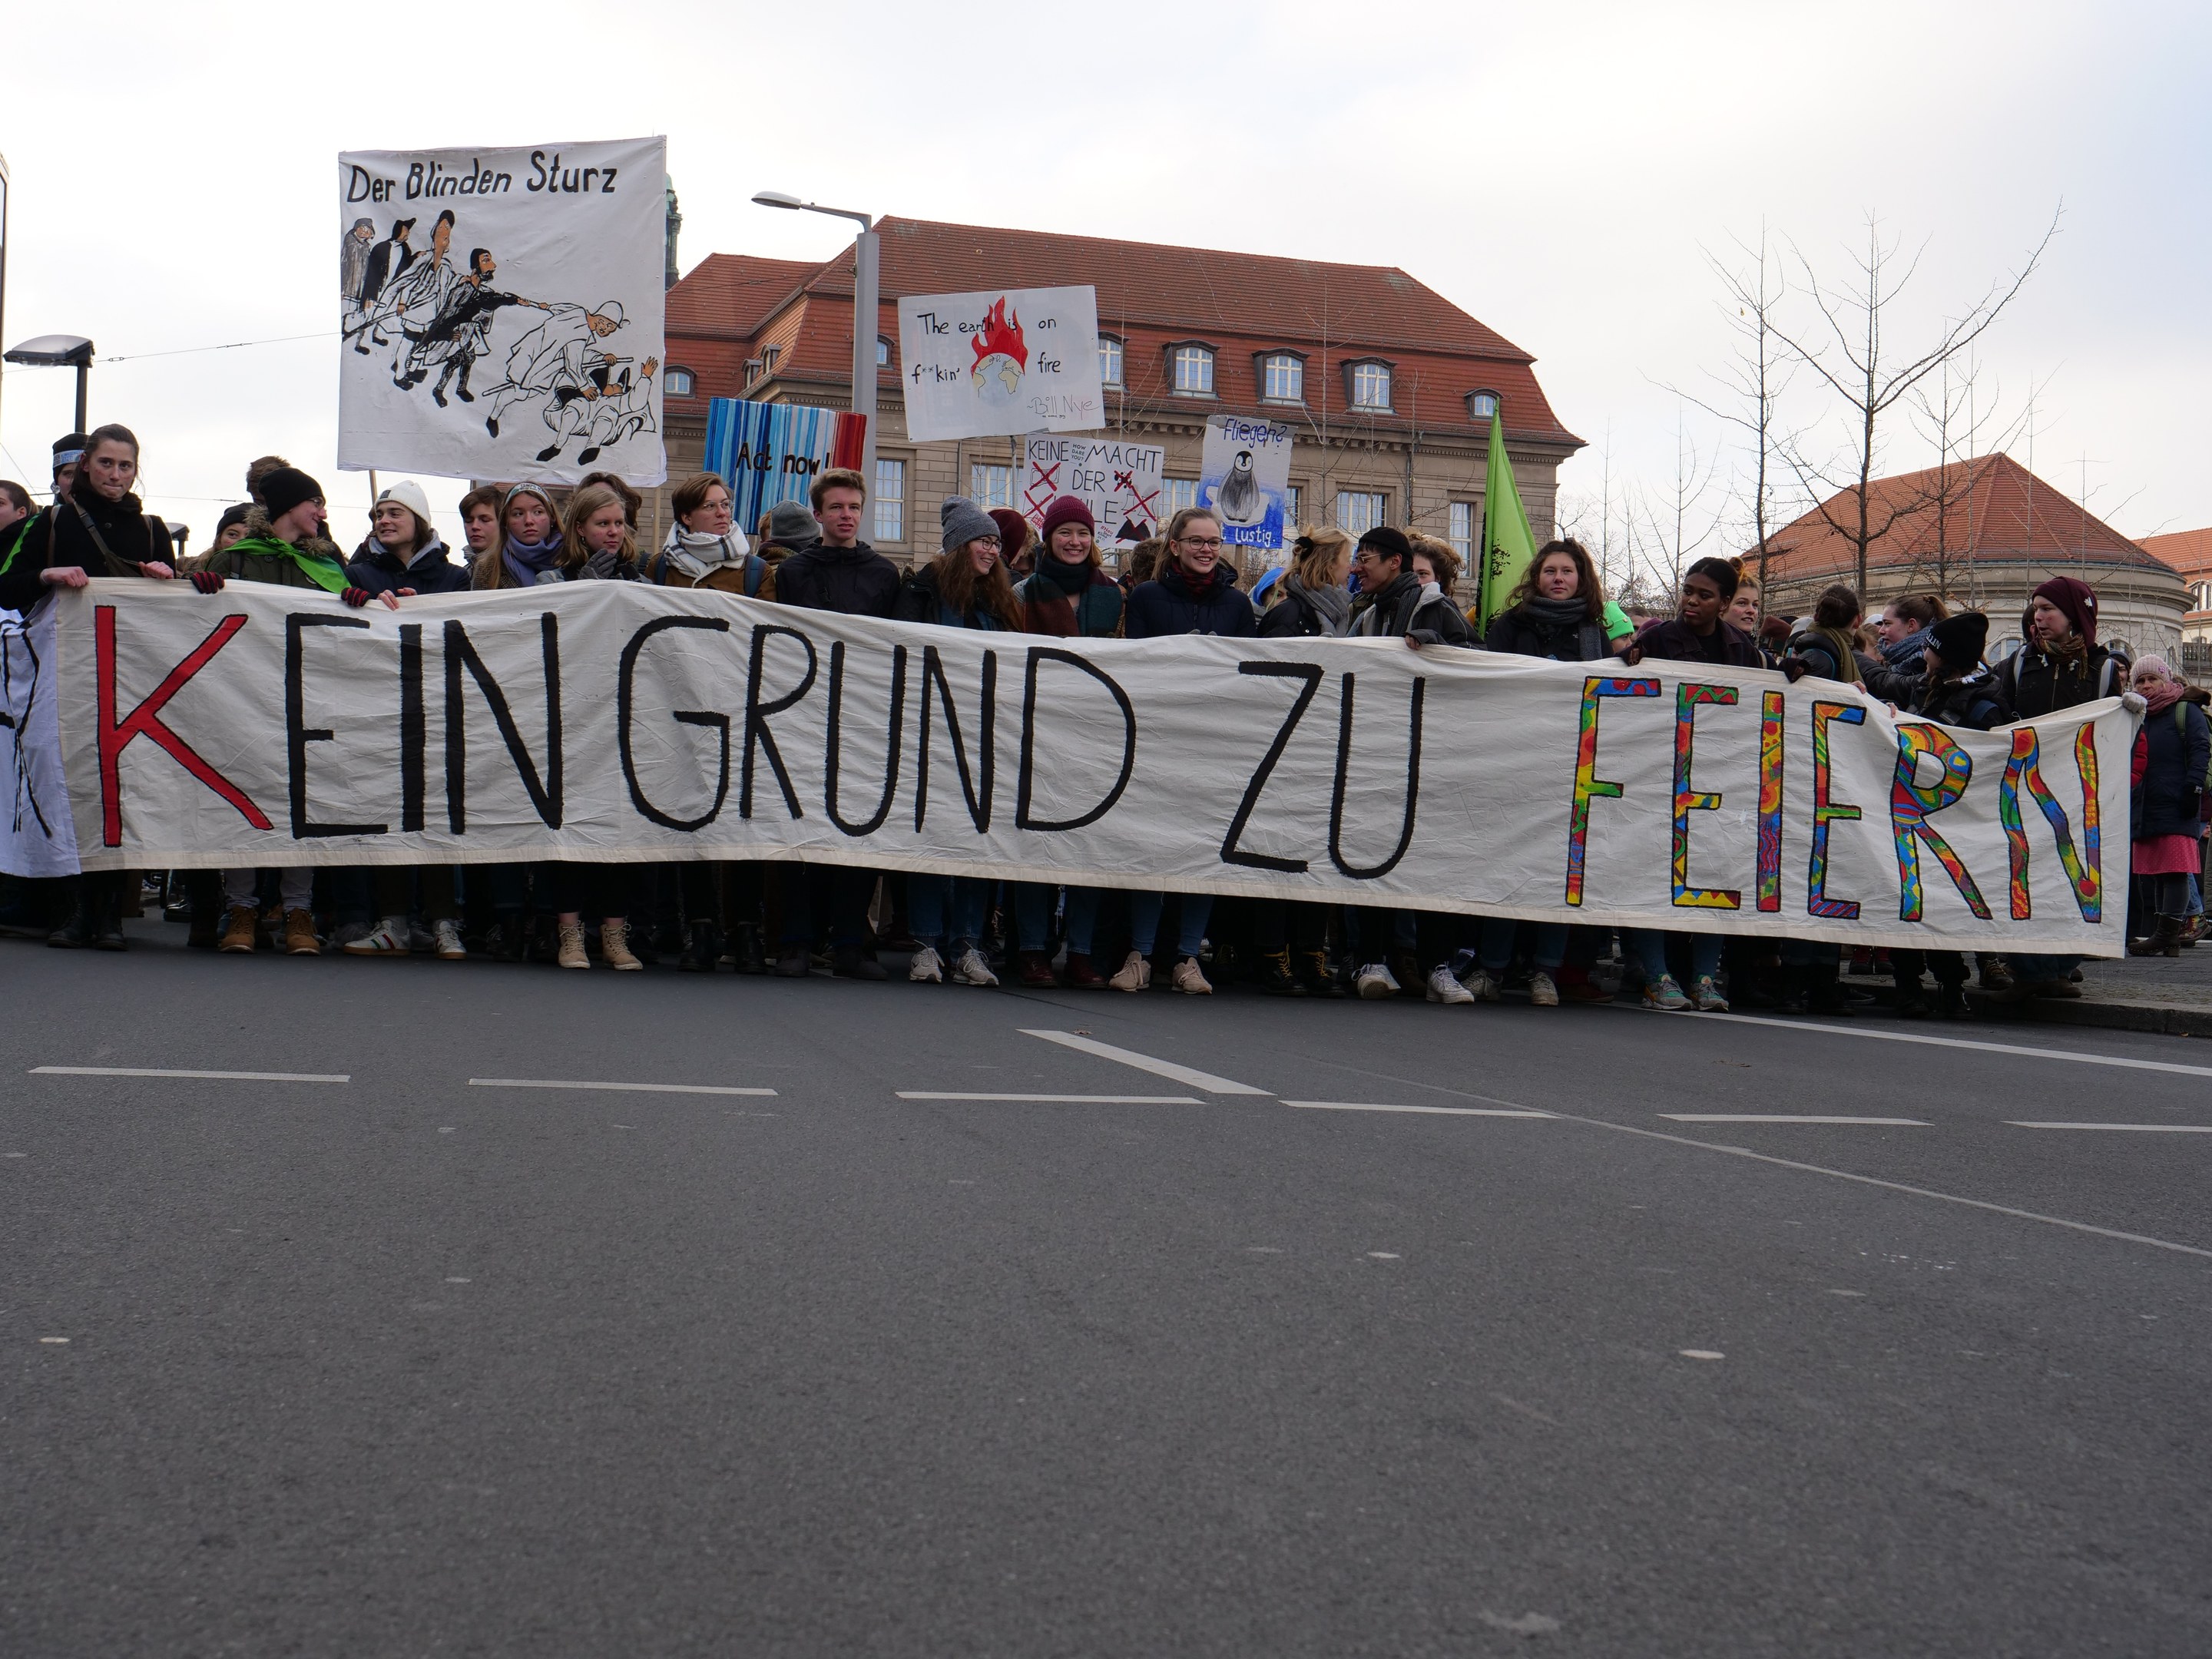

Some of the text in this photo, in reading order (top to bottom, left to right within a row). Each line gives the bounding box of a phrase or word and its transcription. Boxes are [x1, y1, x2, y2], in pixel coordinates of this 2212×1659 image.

[347, 151, 618, 203] Der Blinden Sturz
[917, 313, 1056, 335] The earth is on
[1038, 352, 1061, 373] fire
[1063, 394, 1100, 421] Nye
[1224, 419, 1287, 449] Fliegen?
[736, 442, 773, 472] Act
[1029, 440, 1161, 473] KEINE MACHT
[1072, 469, 1105, 492] DER
[95, 605, 563, 847] KEIN
[618, 615, 1137, 837] GRUND
[1220, 661, 1426, 880] ZU
[1565, 677, 2102, 923] FEIERN
